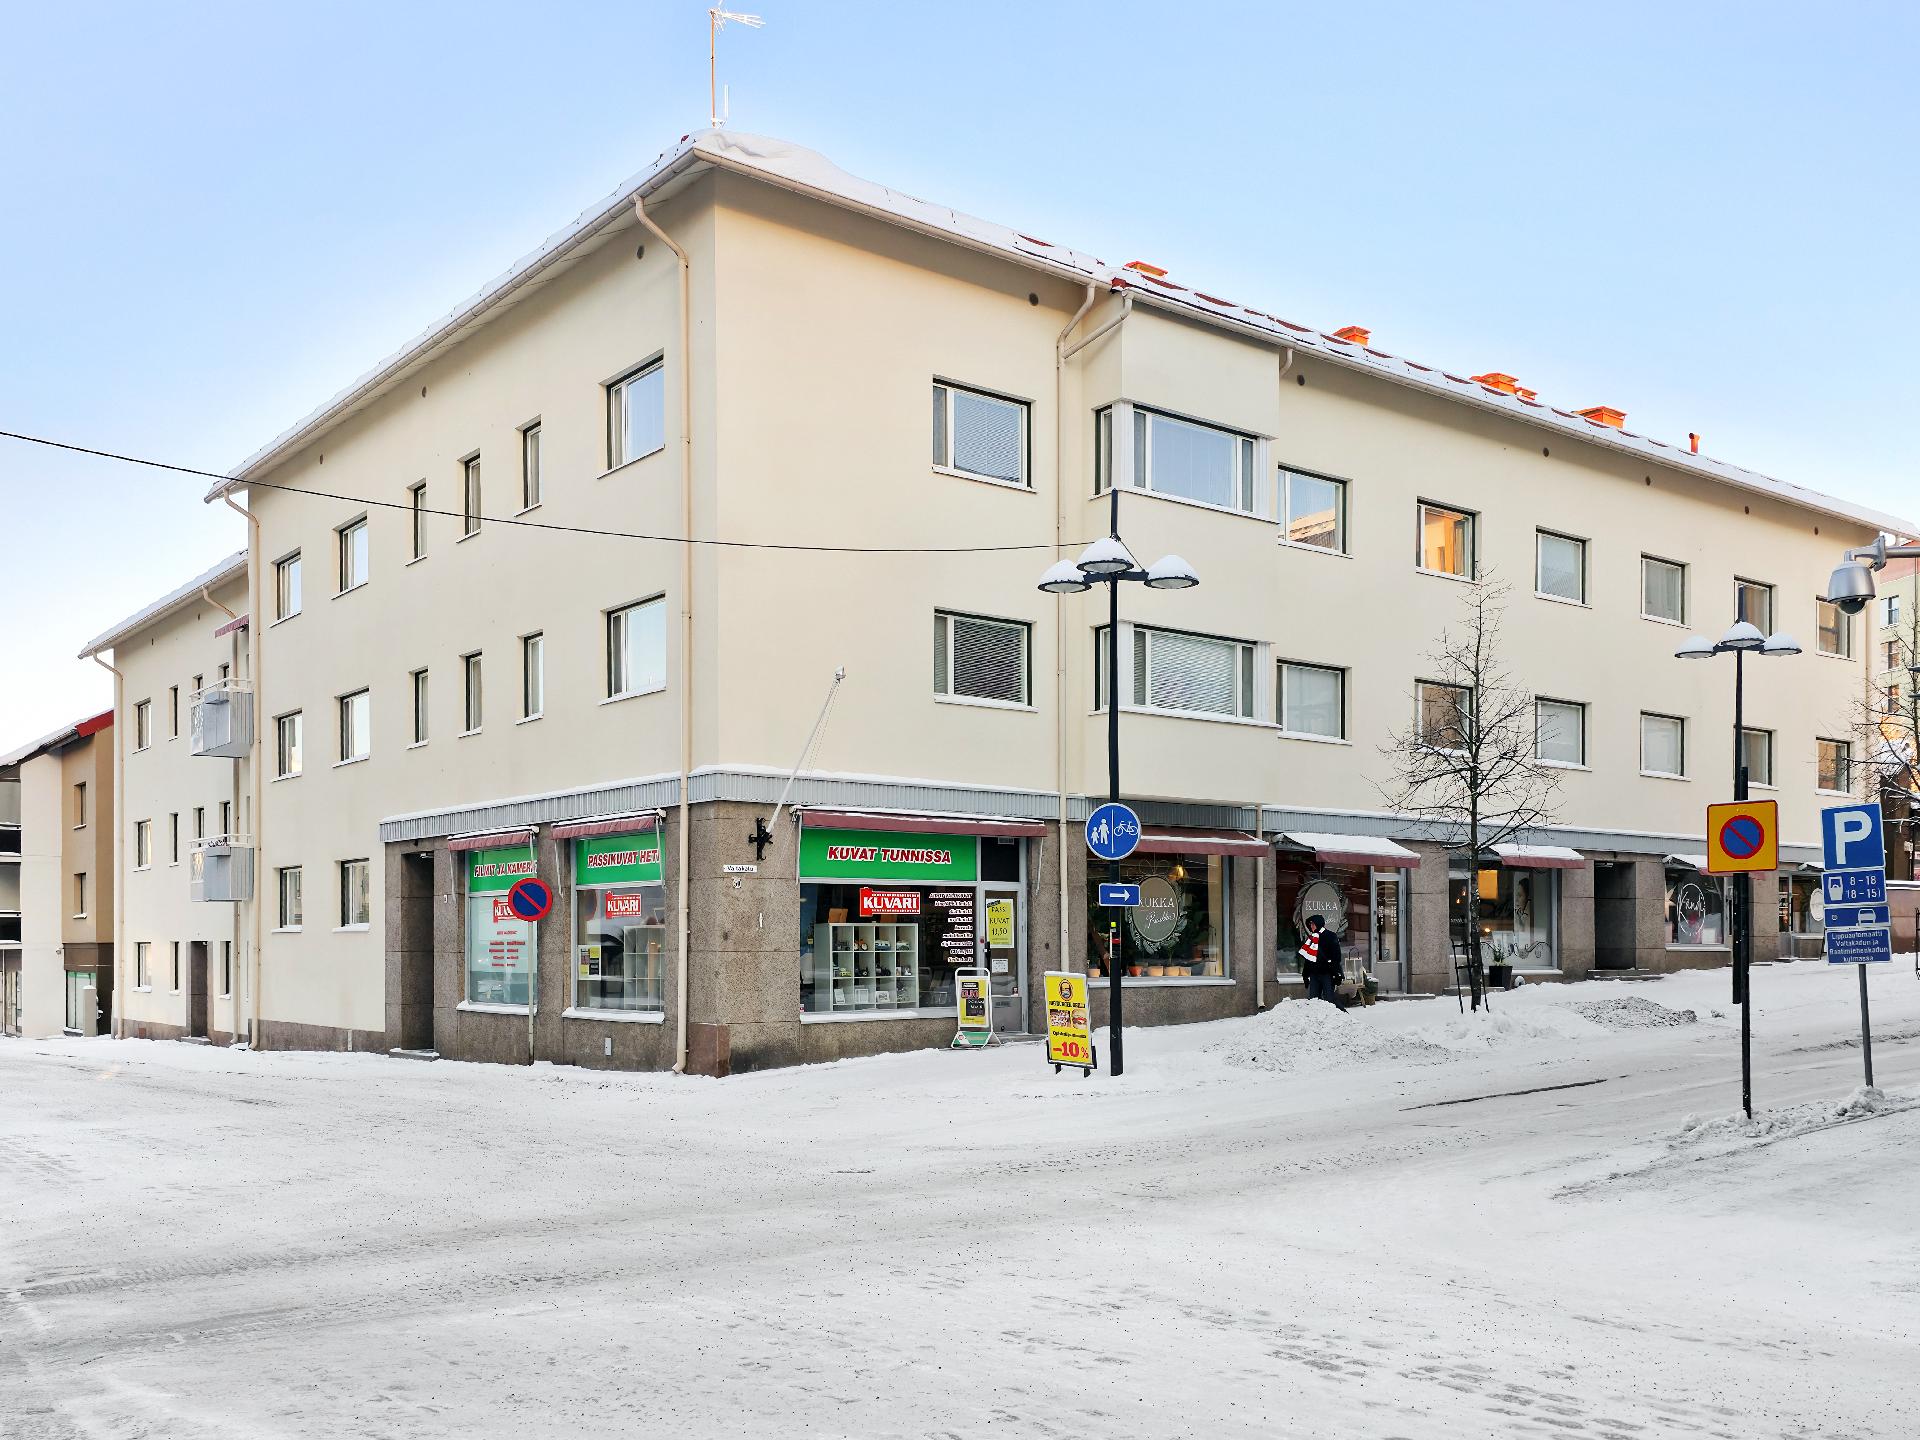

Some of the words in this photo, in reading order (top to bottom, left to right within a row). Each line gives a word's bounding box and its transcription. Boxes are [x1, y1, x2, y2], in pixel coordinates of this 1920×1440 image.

[1834, 811, 1872, 864] P
[587, 851, 638, 868] PASSIKUVAT
[827, 846, 878, 860] KUVAT
[880, 848, 951, 864] TUNNISSA
[474, 864, 497, 877] FILMIT
[496, 863, 505, 876] JA
[506, 860, 537, 875] KAMER
[607, 900, 639, 912] KUVARI
[863, 896, 917, 909] KUVARI
[1305, 900, 1338, 911] KUKKA
[1831, 930, 1883, 941] Lippuautomaatti
[1835, 939, 1871, 947] Valtakadun
